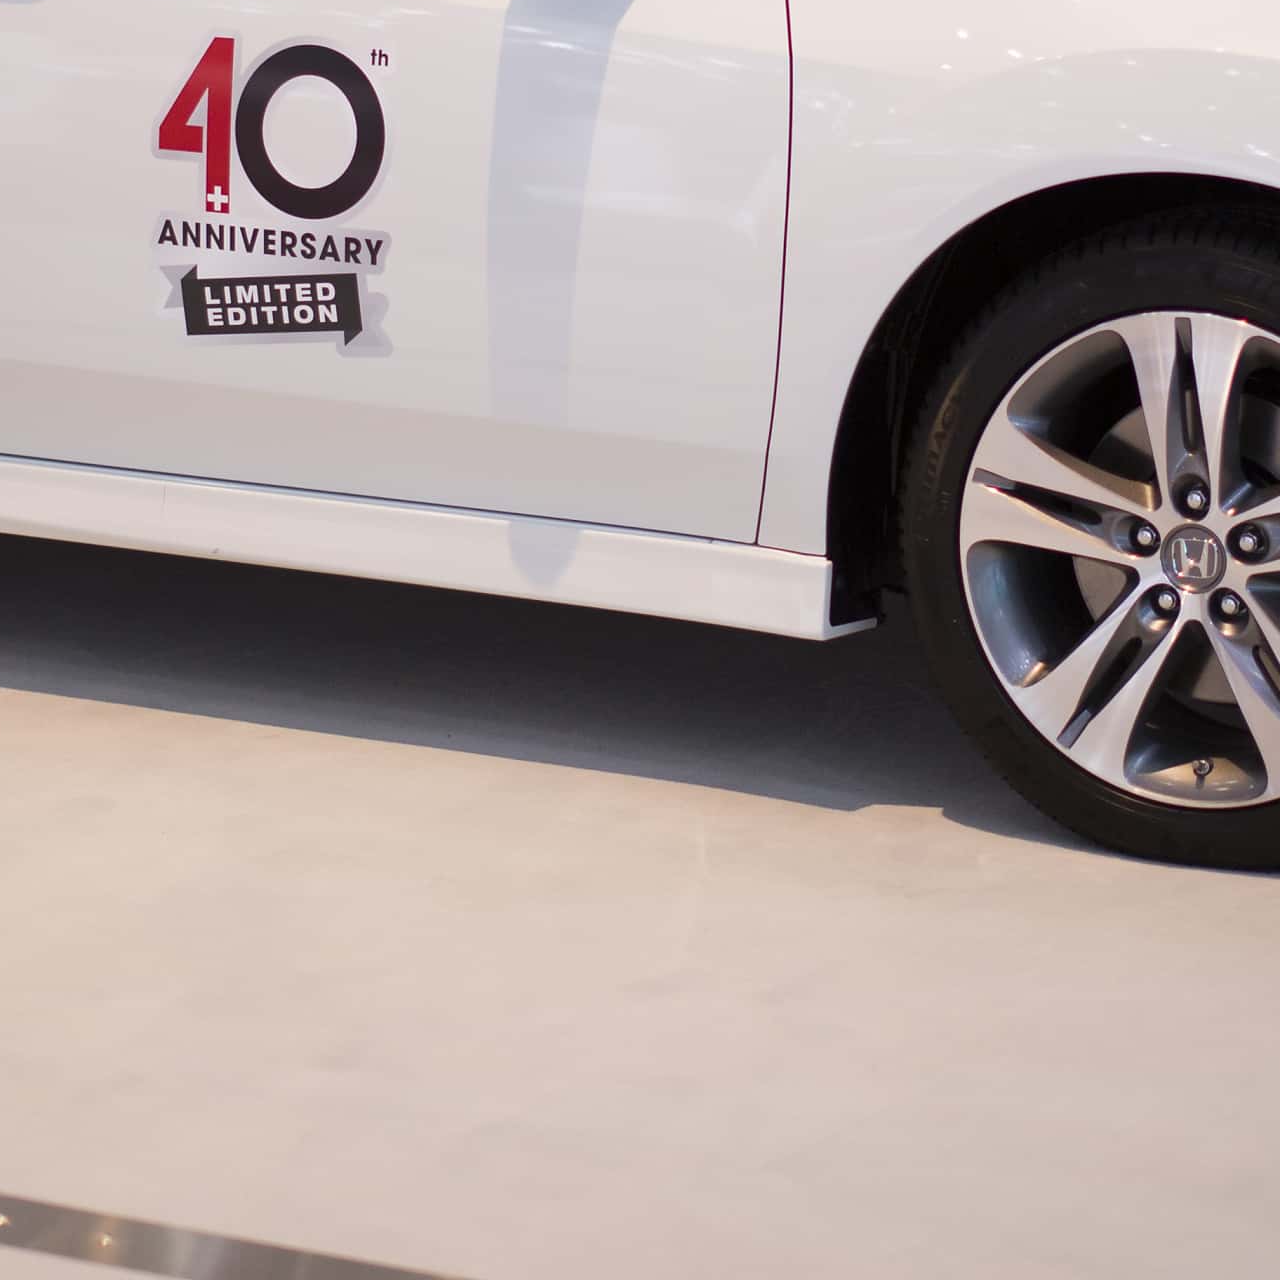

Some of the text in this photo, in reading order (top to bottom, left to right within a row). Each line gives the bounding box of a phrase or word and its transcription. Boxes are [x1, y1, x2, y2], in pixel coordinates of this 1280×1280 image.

[157, 219, 385, 266] ANNIVERSARY
[204, 281, 337, 306] LIMITED
[206, 304, 339, 327] EDITION
